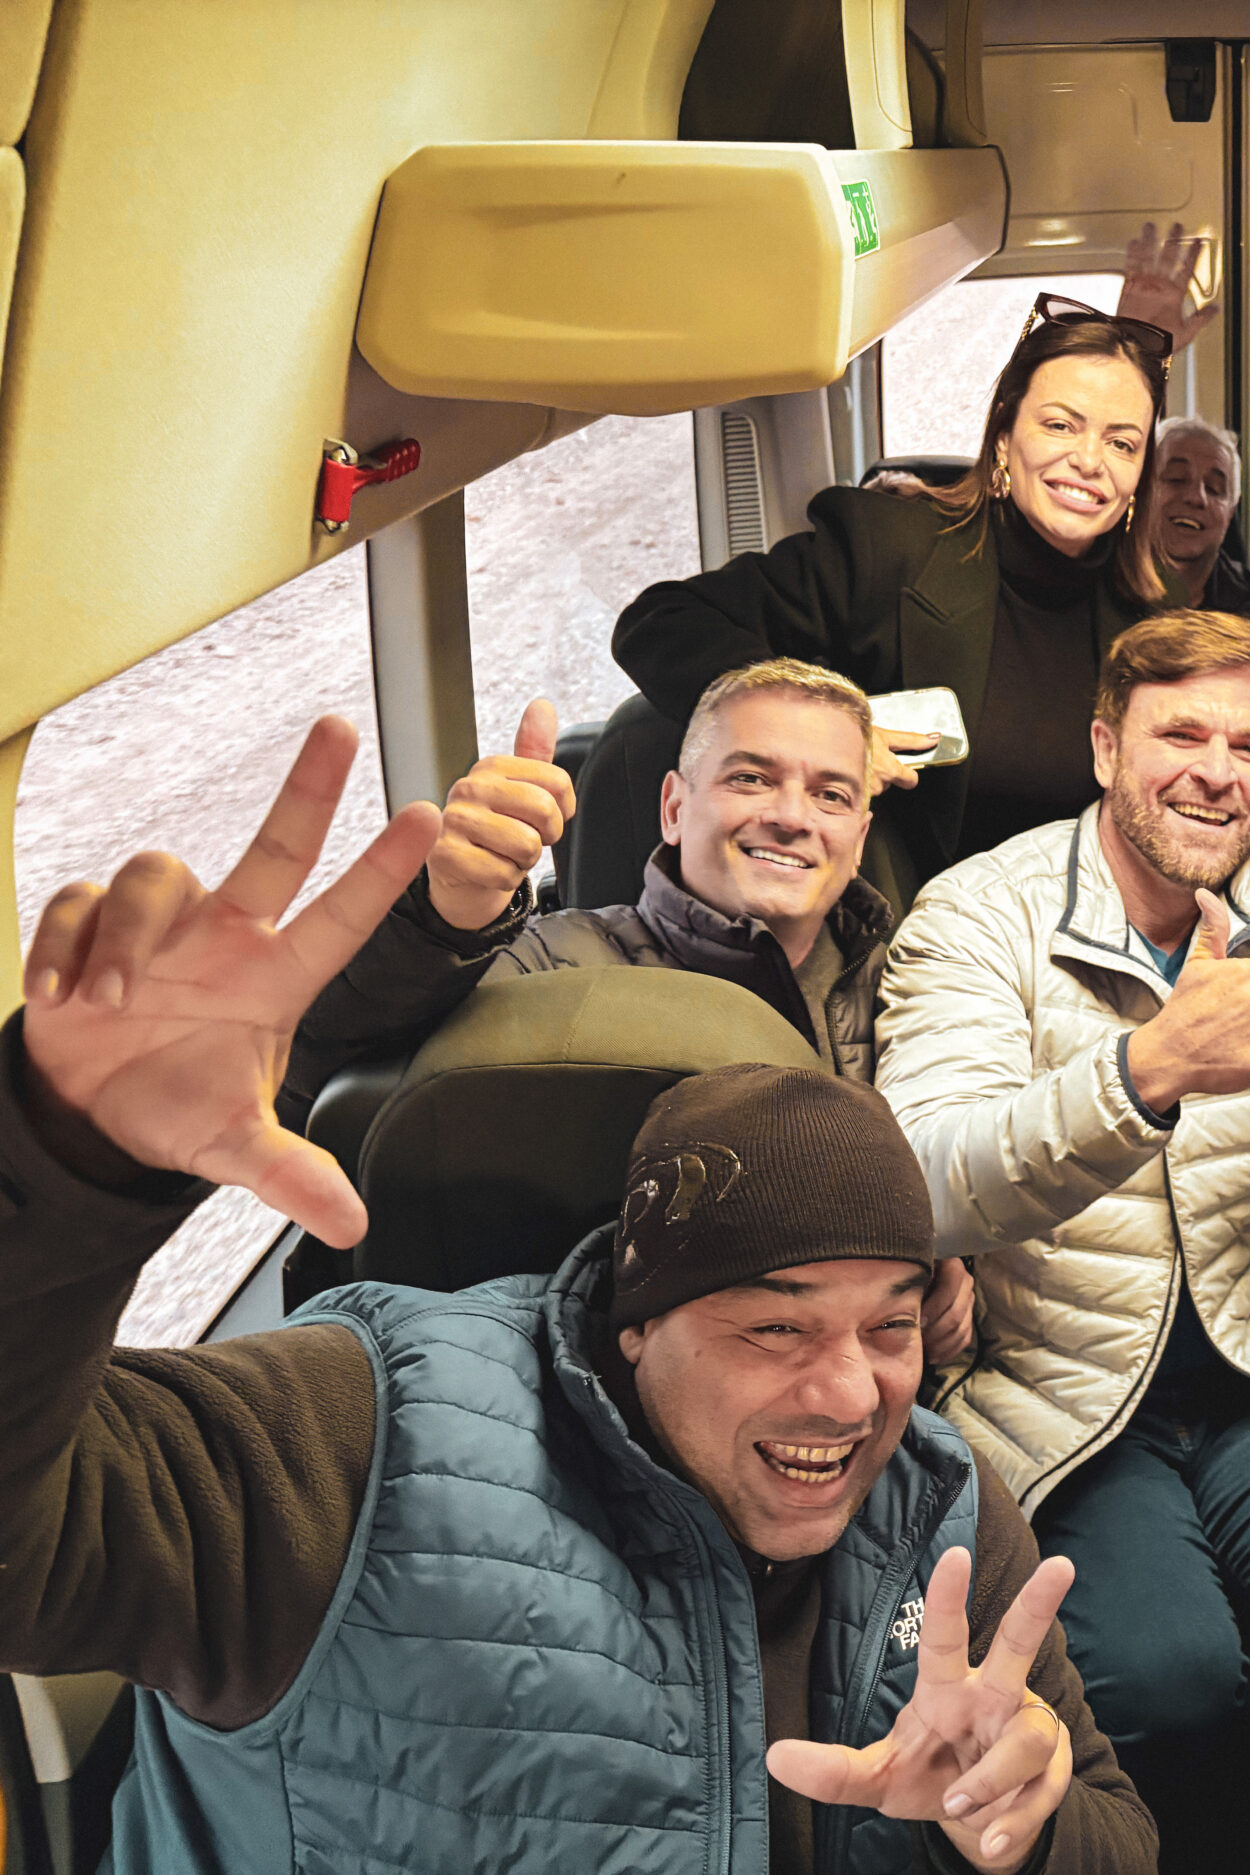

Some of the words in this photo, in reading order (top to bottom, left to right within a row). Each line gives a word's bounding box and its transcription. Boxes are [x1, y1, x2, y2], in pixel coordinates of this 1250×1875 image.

[901, 1597, 925, 1617] TH
[889, 1614, 924, 1639] ORT
[900, 1631, 920, 1650] FA
